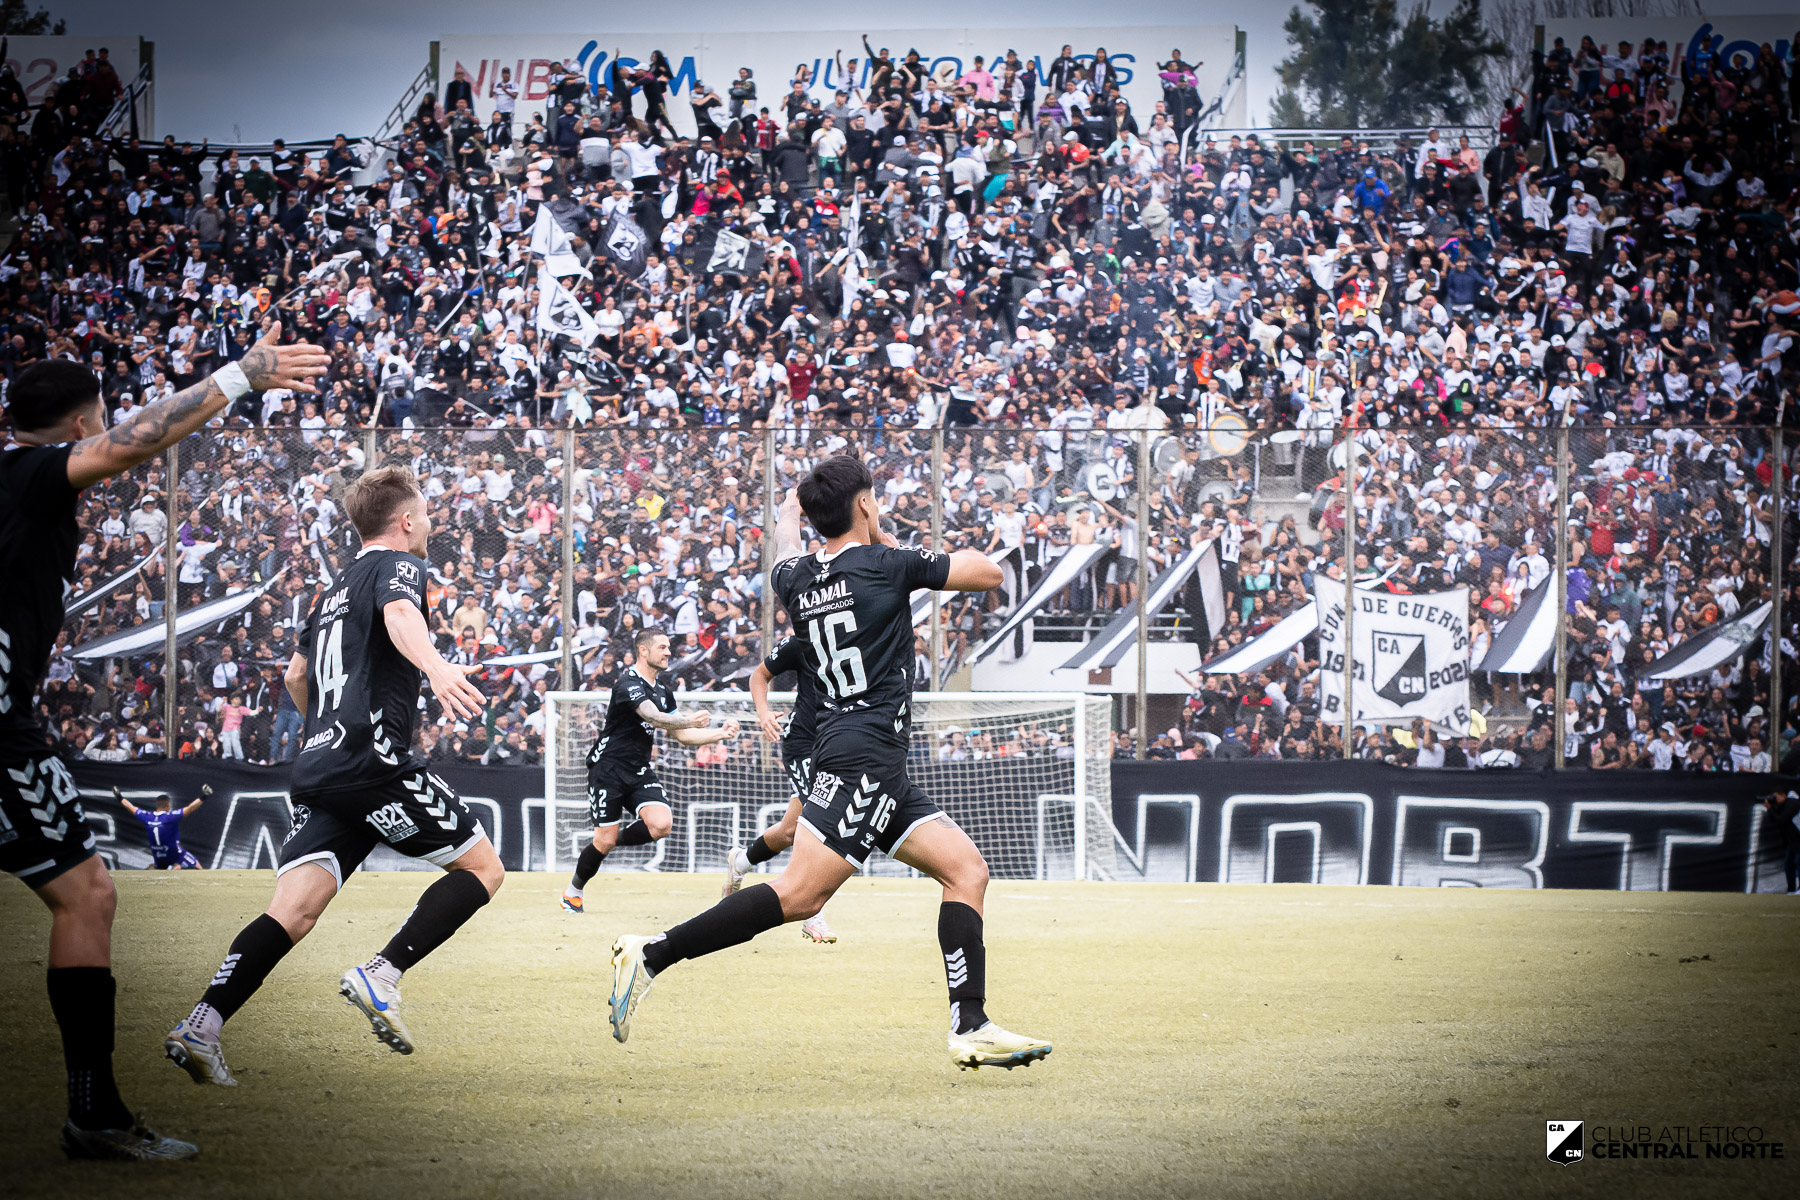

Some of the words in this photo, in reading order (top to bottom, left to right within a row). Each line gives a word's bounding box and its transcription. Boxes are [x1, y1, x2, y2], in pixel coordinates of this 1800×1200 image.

[798, 579, 853, 610] KAMAL
[1361, 597, 1388, 615] DE
[809, 610, 868, 700] 16
[1377, 637, 1401, 655] CA
[314, 618, 349, 719] 14
[1398, 676, 1425, 694] CN
[598, 789, 608, 808] 2
[869, 793, 897, 834] 16
[365, 802, 415, 837] 1921
[152, 826, 161, 846] 1
[1036, 793, 1785, 894] NORT
